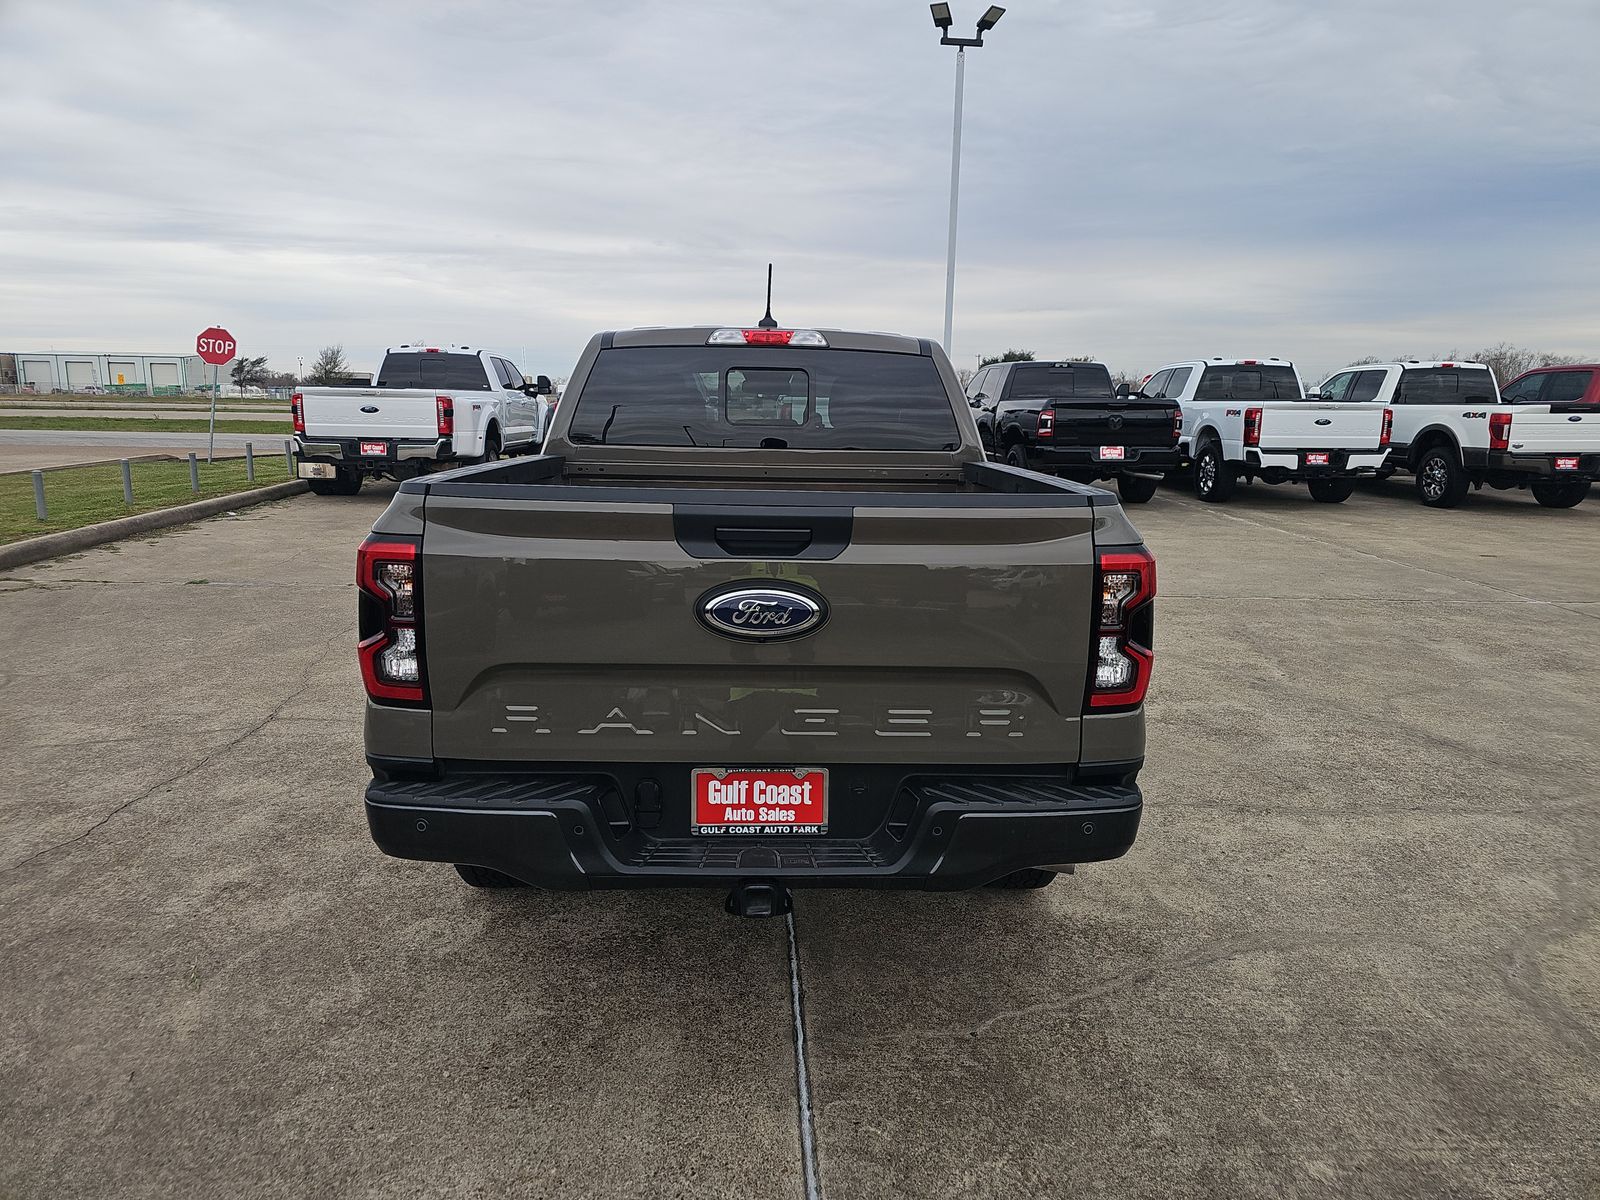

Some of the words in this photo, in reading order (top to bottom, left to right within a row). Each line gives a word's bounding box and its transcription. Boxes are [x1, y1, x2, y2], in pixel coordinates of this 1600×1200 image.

[199, 338, 234, 355] STOP
[732, 599, 793, 625] Ford
[491, 704, 1025, 737] RANGER
[708, 780, 749, 805] Gulf
[753, 780, 812, 805] Coast
[724, 807, 755, 821] Auto
[758, 807, 796, 821] Sales
[700, 826, 726, 834] GULF
[729, 826, 761, 834] COAST
[764, 826, 790, 834] AUTO
[793, 826, 819, 834] PARK
